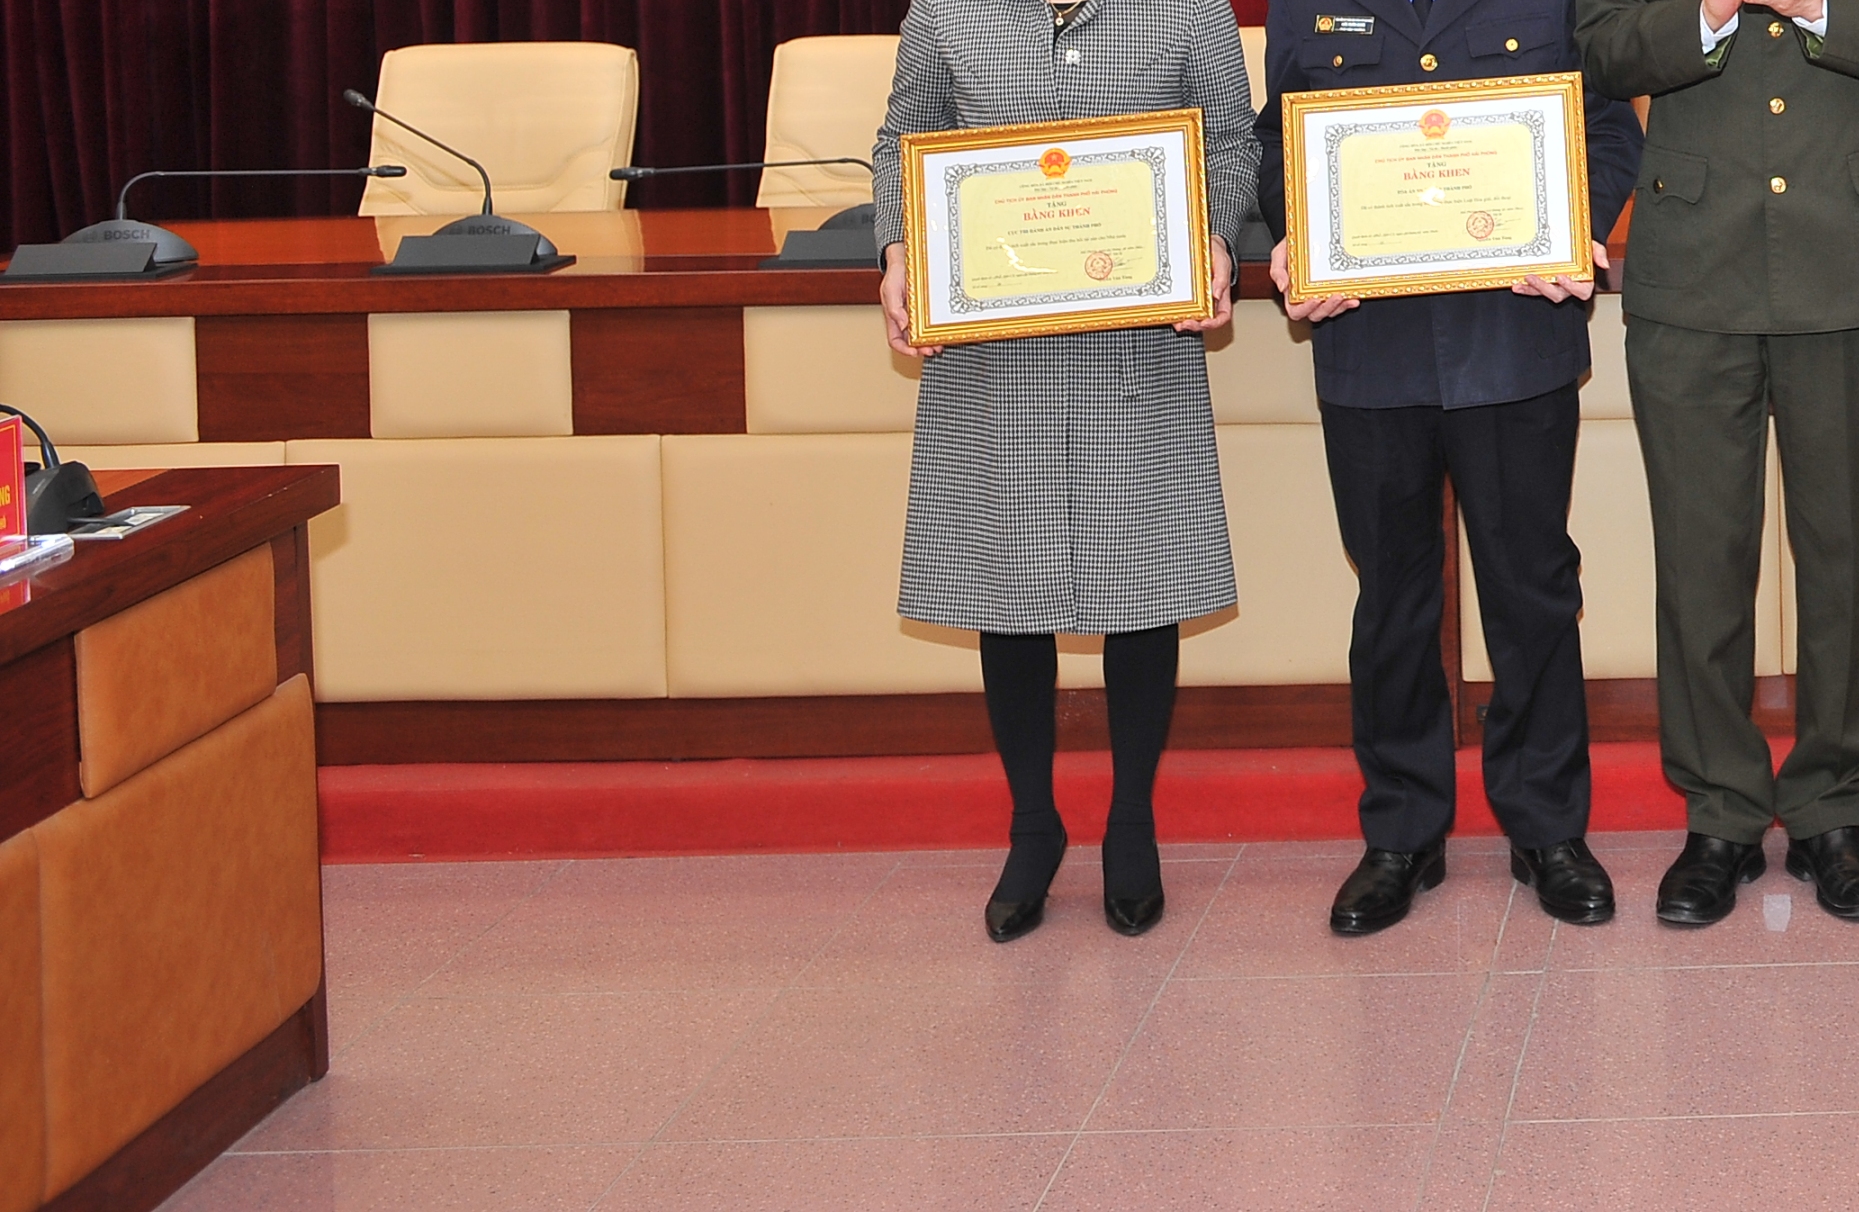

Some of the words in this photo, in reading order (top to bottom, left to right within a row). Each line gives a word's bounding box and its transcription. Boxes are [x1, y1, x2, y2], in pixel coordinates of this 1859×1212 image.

[1404, 169, 1435, 181] BẰNG
[1439, 168, 1470, 178] KHEN
[1024, 207, 1055, 221] BẰNG
[1059, 205, 1091, 218] KHEN
[103, 229, 151, 241] BOSCH
[467, 224, 512, 236] BOSCH
